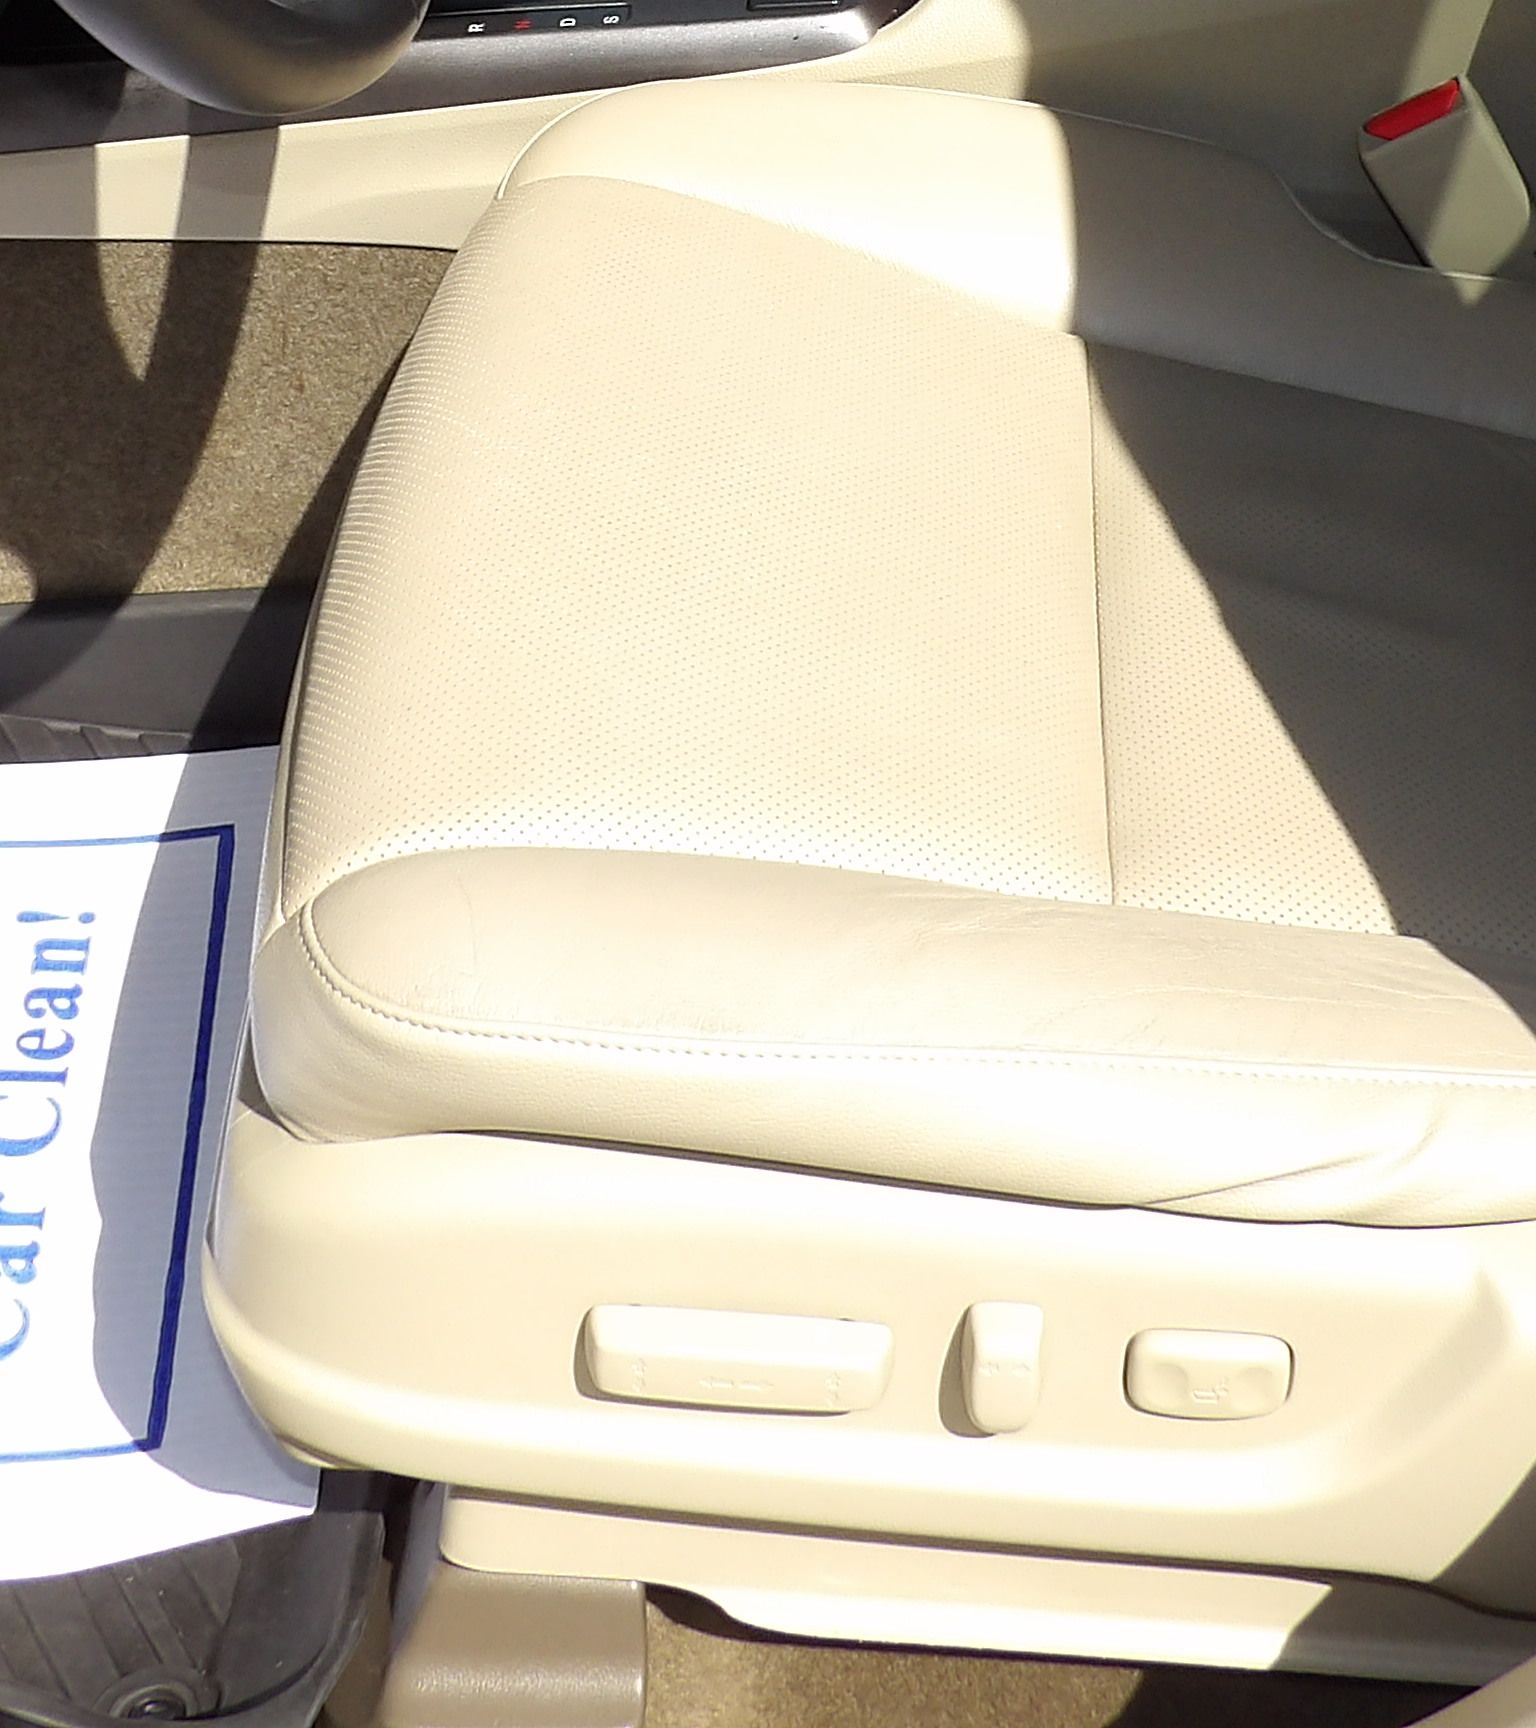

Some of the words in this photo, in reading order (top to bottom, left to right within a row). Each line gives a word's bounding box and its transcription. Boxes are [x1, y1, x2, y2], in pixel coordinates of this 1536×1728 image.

[468, 21, 485, 34] R
[560, 16, 576, 29] D
[602, 14, 619, 26] S
